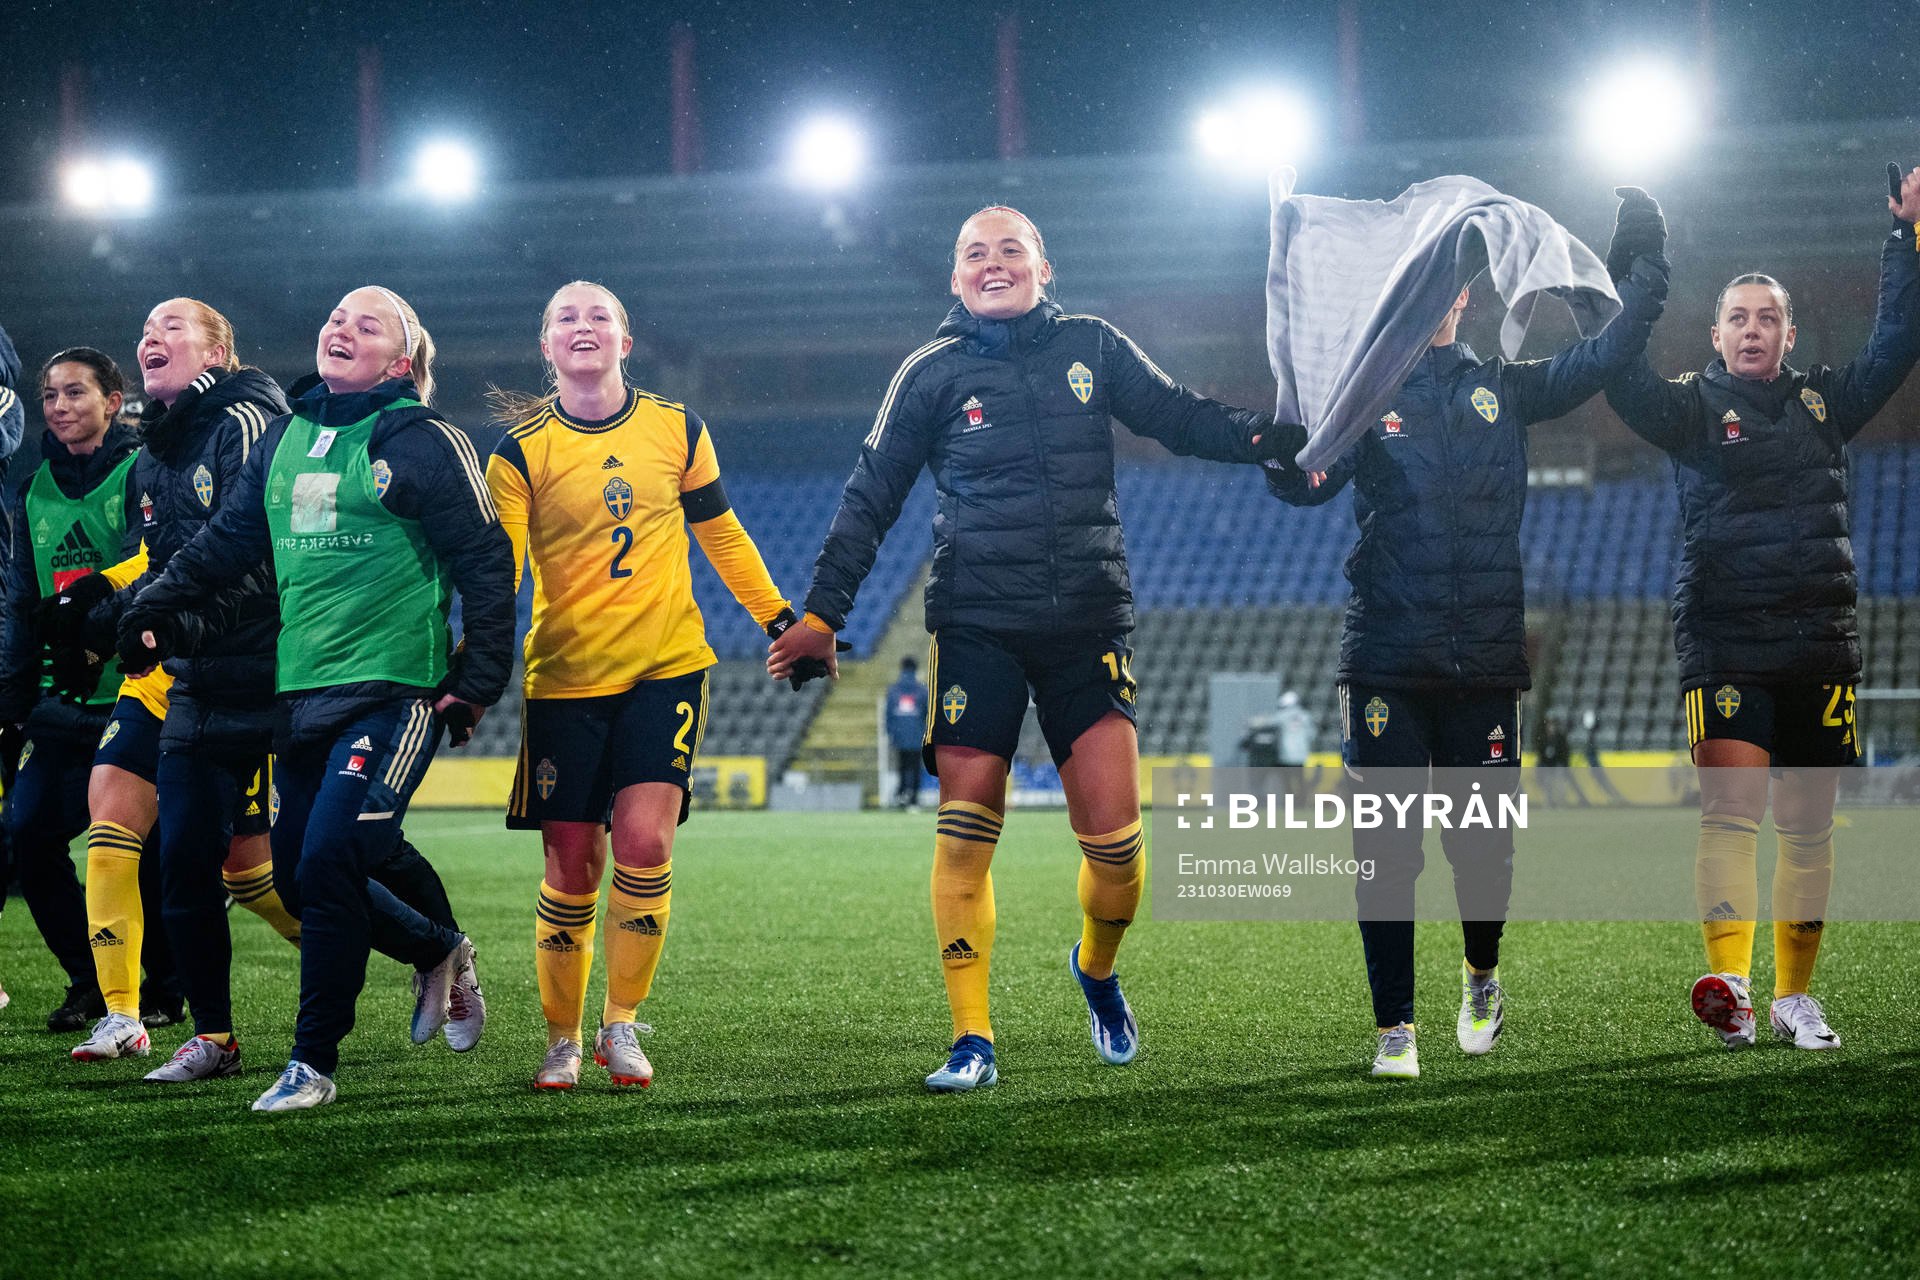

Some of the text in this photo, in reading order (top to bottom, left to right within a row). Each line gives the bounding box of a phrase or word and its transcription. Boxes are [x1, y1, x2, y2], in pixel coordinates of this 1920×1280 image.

[962, 402, 983, 412] adidas
[601, 462, 624, 470] adidas
[50, 549, 104, 568] adidas
[610, 526, 634, 579] 2
[673, 701, 694, 755] 2
[350, 743, 373, 752] adidas
[619, 920, 664, 936] adidas
[538, 940, 584, 953] adidas
